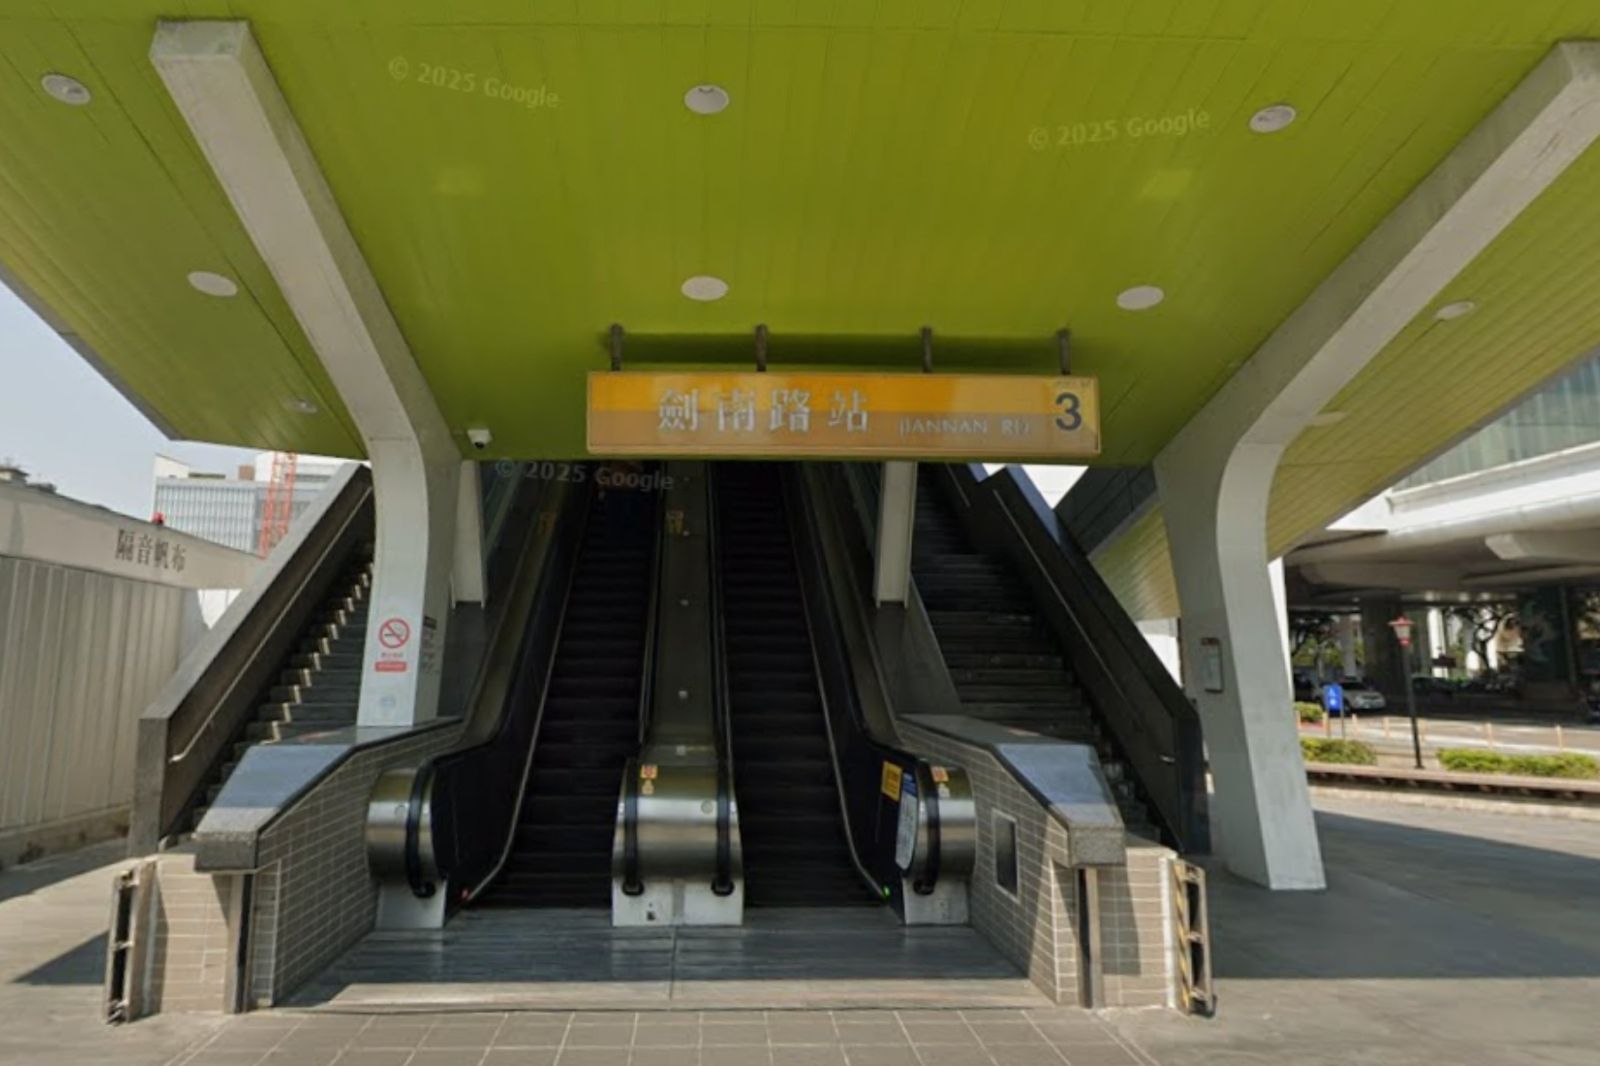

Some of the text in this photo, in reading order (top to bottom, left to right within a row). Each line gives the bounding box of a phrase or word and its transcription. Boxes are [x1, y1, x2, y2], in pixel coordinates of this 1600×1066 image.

[658, 387, 870, 433] 劍南路站
[1054, 391, 1082, 431] 3
